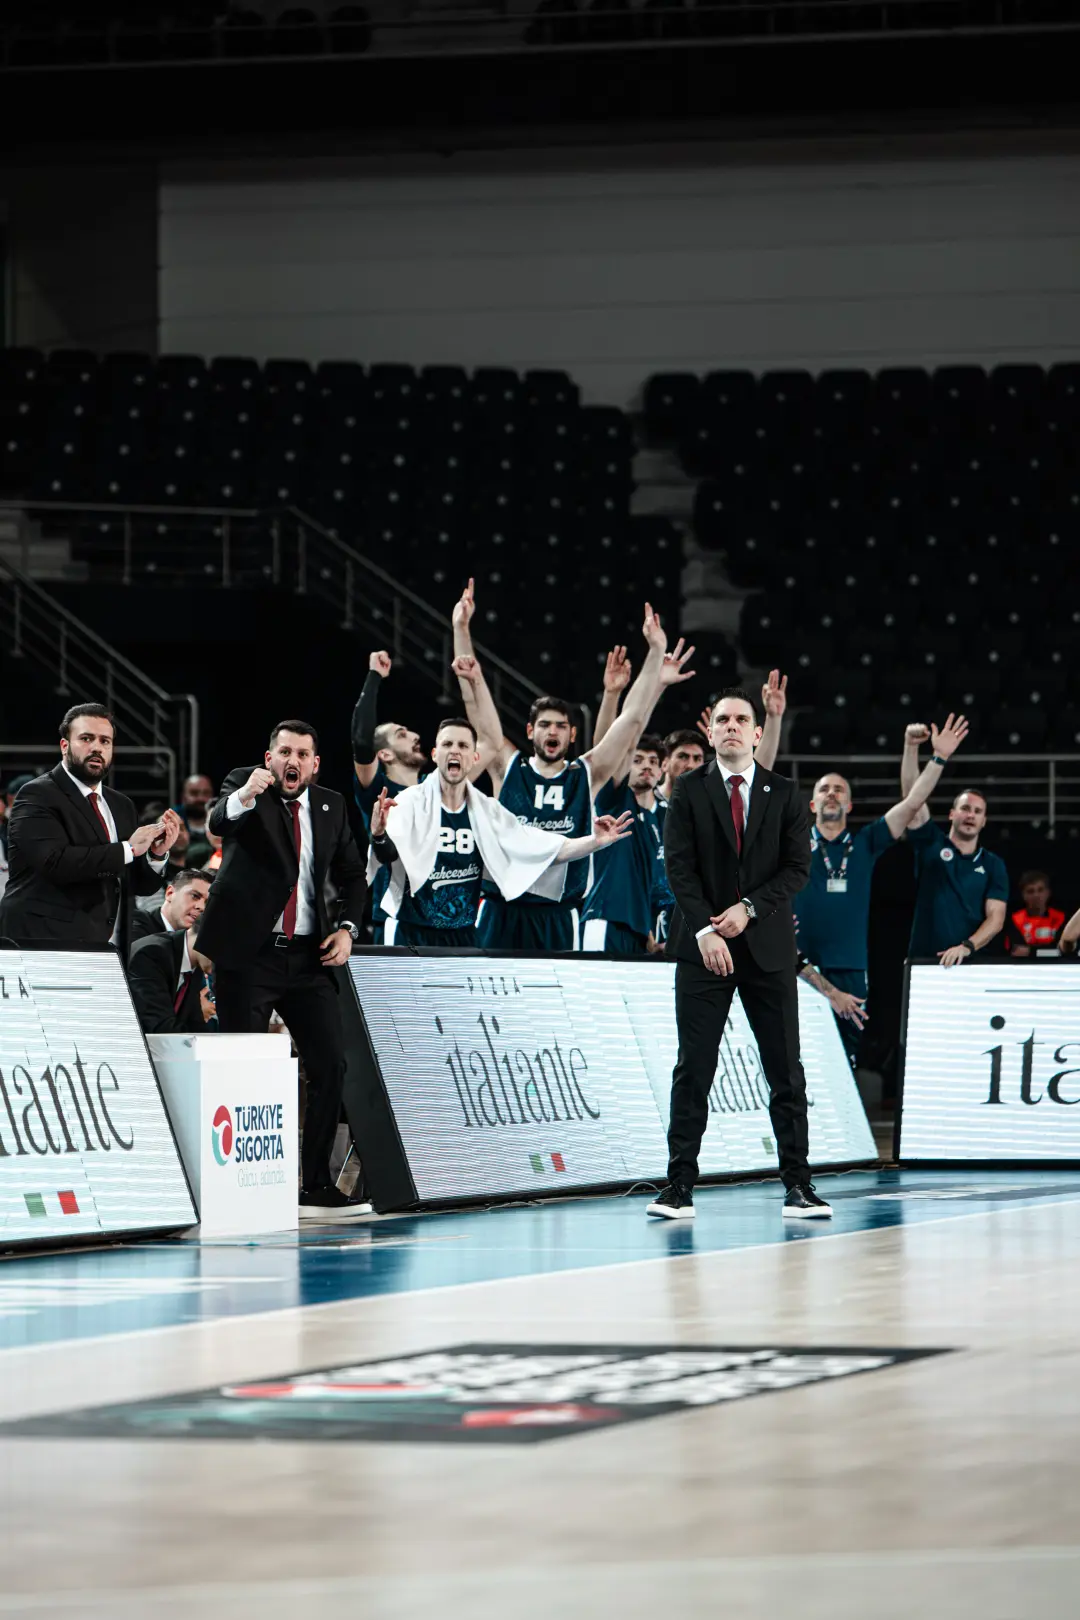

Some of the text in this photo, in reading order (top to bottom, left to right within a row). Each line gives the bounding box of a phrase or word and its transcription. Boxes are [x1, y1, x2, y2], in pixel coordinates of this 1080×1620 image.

[534, 784, 565, 811] 14
[437, 826, 475, 855] 28
[435, 1011, 601, 1128] italiante
